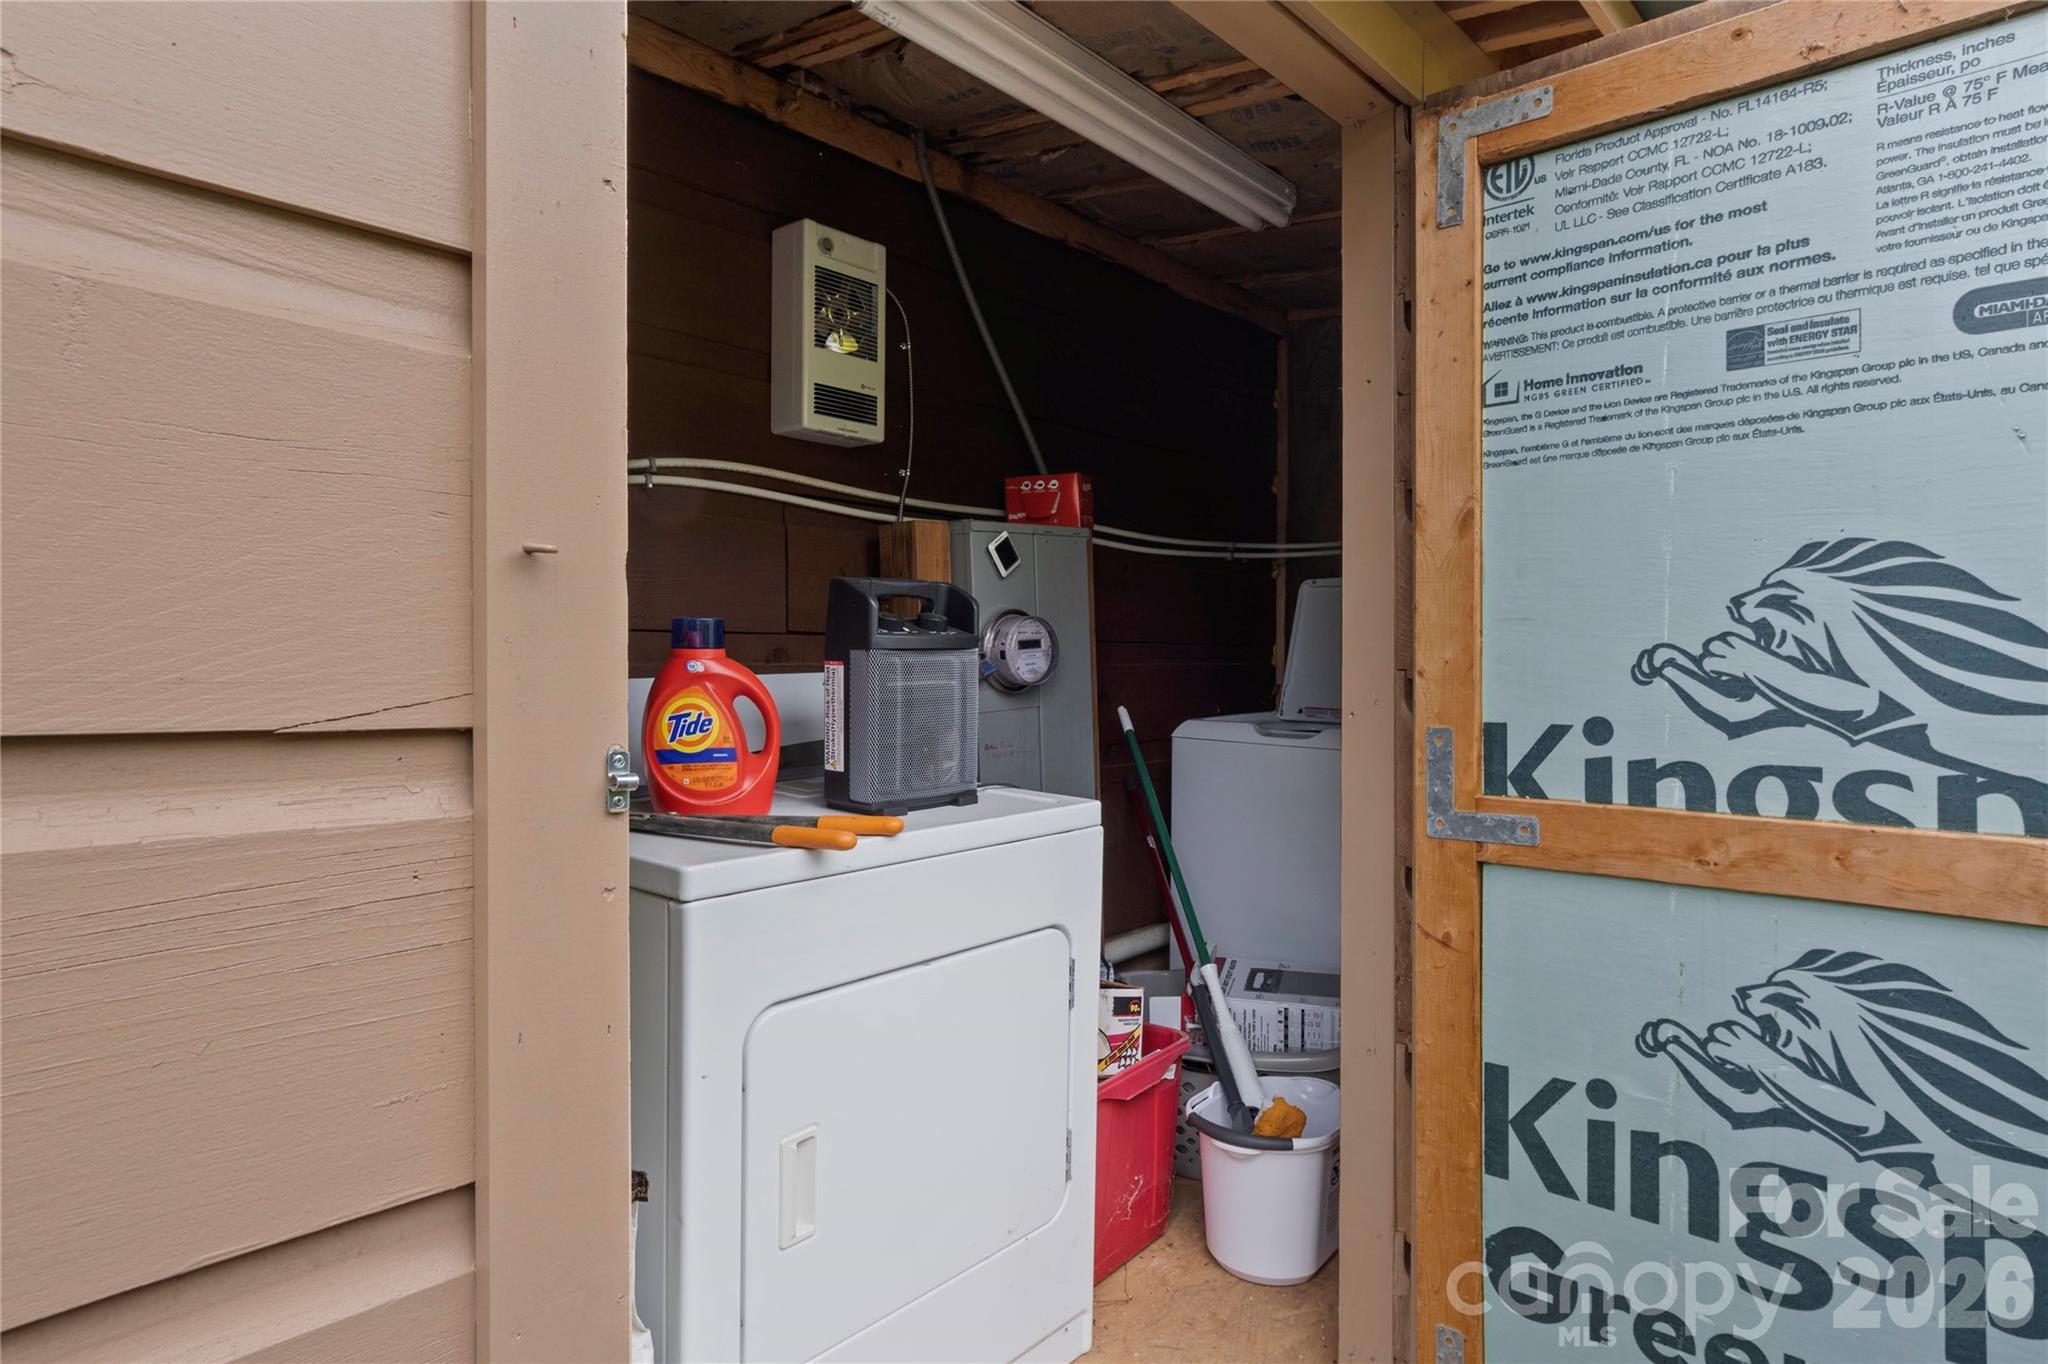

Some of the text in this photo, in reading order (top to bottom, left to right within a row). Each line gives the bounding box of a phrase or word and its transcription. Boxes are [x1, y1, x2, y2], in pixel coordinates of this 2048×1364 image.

[1877, 33, 2015, 79] Thickness, inches
[1877, 58, 1980, 93] Épaisseur, po
[1877, 92, 1936, 115] R-Value
[1943, 85, 1956, 97] @
[1964, 76, 1990, 93] 75°
[1996, 71, 2007, 83] F
[1877, 109, 1924, 128] Valeur
[1929, 104, 1940, 115] R
[1962, 94, 1981, 107] 75
[1988, 87, 1999, 100] F
[1555, 80, 1828, 165] Florida Product Approval No. FL14164-R5;
[1876, 143, 1885, 151] R
[1887, 135, 1922, 149] means
[1925, 122, 1981, 140] resistance
[1998, 109, 2024, 122] heat
[1876, 121, 2041, 167] power. The insulation must be
[1555, 127, 1729, 181] Voir Rapport CCMC 12722-L;
[1555, 174, 1622, 198] Miami-Dade
[1626, 161, 1670, 180] County,
[1674, 155, 1690, 167] FL
[1703, 143, 1733, 160] NOA
[1738, 139, 1760, 150] No.
[1623, 185, 1645, 198] Voir
[1649, 170, 1698, 191] Rapport
[1701, 158, 1745, 178] CCMC
[1751, 142, 1812, 166] 12722-L;
[1953, 150, 1987, 163] obtain
[1555, 157, 1827, 232] UL LLC See Classification Certificate A183.
[1876, 181, 1914, 195] Atlanta,
[1917, 176, 1935, 186] GA
[1876, 168, 2043, 210] La lettre R signifie la résistance
[1876, 210, 1914, 225] pouvoir
[2017, 182, 2040, 194] doit
[1484, 201, 1768, 275] Go to www.kingspan.com/us for the most
[1876, 227, 1905, 239] Avant
[1962, 213, 1976, 221] un
[1978, 203, 2019, 220] produit
[1876, 223, 1998, 253] votre fournisseur ou de
[1484, 237, 1693, 291] current compliance information.
[1484, 299, 1512, 313] Allez
[1526, 258, 1713, 304] www.kingspaninsulation.ca
[1717, 249, 1752, 267] pour
[1757, 245, 1770, 256] la
[1776, 237, 1810, 255] plus
[1483, 252, 1836, 329] récente information sur la conformité aux normes.
[1483, 262, 2020, 362] AVERTISSEMENT: Ce produit est combustible. Une barrière protectrice ou thermique est requise. tel que
[1532, 331, 1548, 341] This
[1550, 324, 1584, 340] product
[1596, 311, 1654, 329] combustible.
[1658, 308, 1665, 317] A
[1668, 299, 1716, 317] protective
[1719, 292, 1751, 306] barrier
[1755, 291, 1765, 299] or
[1769, 288, 1776, 296] a
[1780, 278, 1820, 295] thermal
[1823, 270, 1861, 287] barrier
[1864, 270, 1873, 280] is
[1877, 259, 1926, 278] required
[1930, 258, 1945, 268] as
[1949, 244, 2007, 265] specified
[2011, 242, 2022, 253] in
[1767, 326, 1788, 336] Seal
[1790, 323, 1808, 332] and
[1767, 325, 1857, 347] with ENERGY STAR
[1524, 364, 1643, 391] Home Innovation
[1554, 387, 1586, 398] GREEN
[1521, 405, 1586, 421] the and
[667, 711, 714, 744] Tide
